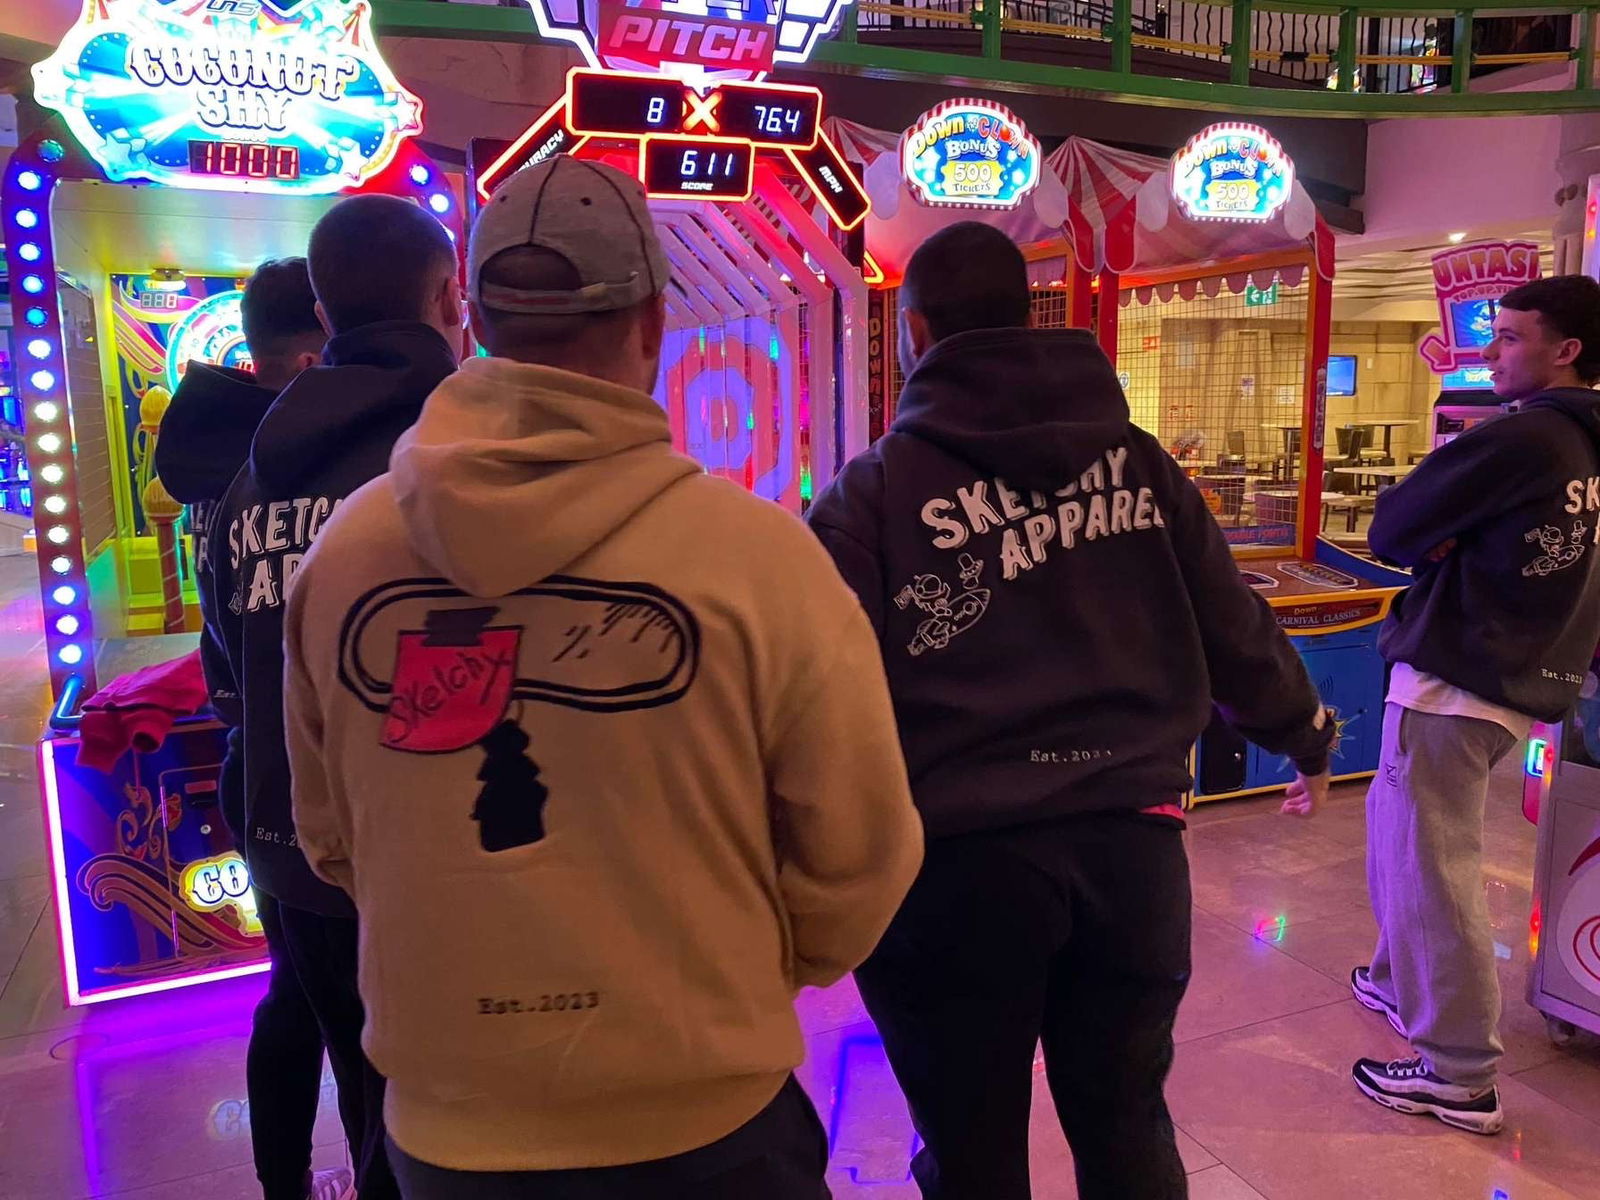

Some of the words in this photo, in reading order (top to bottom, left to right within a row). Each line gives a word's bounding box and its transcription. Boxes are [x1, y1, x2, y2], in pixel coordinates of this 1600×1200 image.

[608, 15, 768, 61] PITCH
[130, 46, 356, 101] COCONUT
[196, 88, 293, 131] SHY
[647, 97, 665, 123] 8
[206, 143, 296, 179] 1000
[945, 139, 1001, 160] BONUS
[680, 150, 733, 176] 611
[954, 163, 992, 182] 500
[1209, 157, 1258, 179] BONUS
[681, 181, 714, 191] SCORE
[819, 166, 843, 194] MPH
[952, 183, 992, 193] TICKETS
[1216, 183, 1250, 200] 500
[920, 447, 1128, 550] SKEHY
[229, 497, 340, 570] SKETC
[1275, 616, 1320, 625] CARNIVAL
[1323, 609, 1361, 623] CLASSICS
[478, 991, 599, 1015] Est.2023
